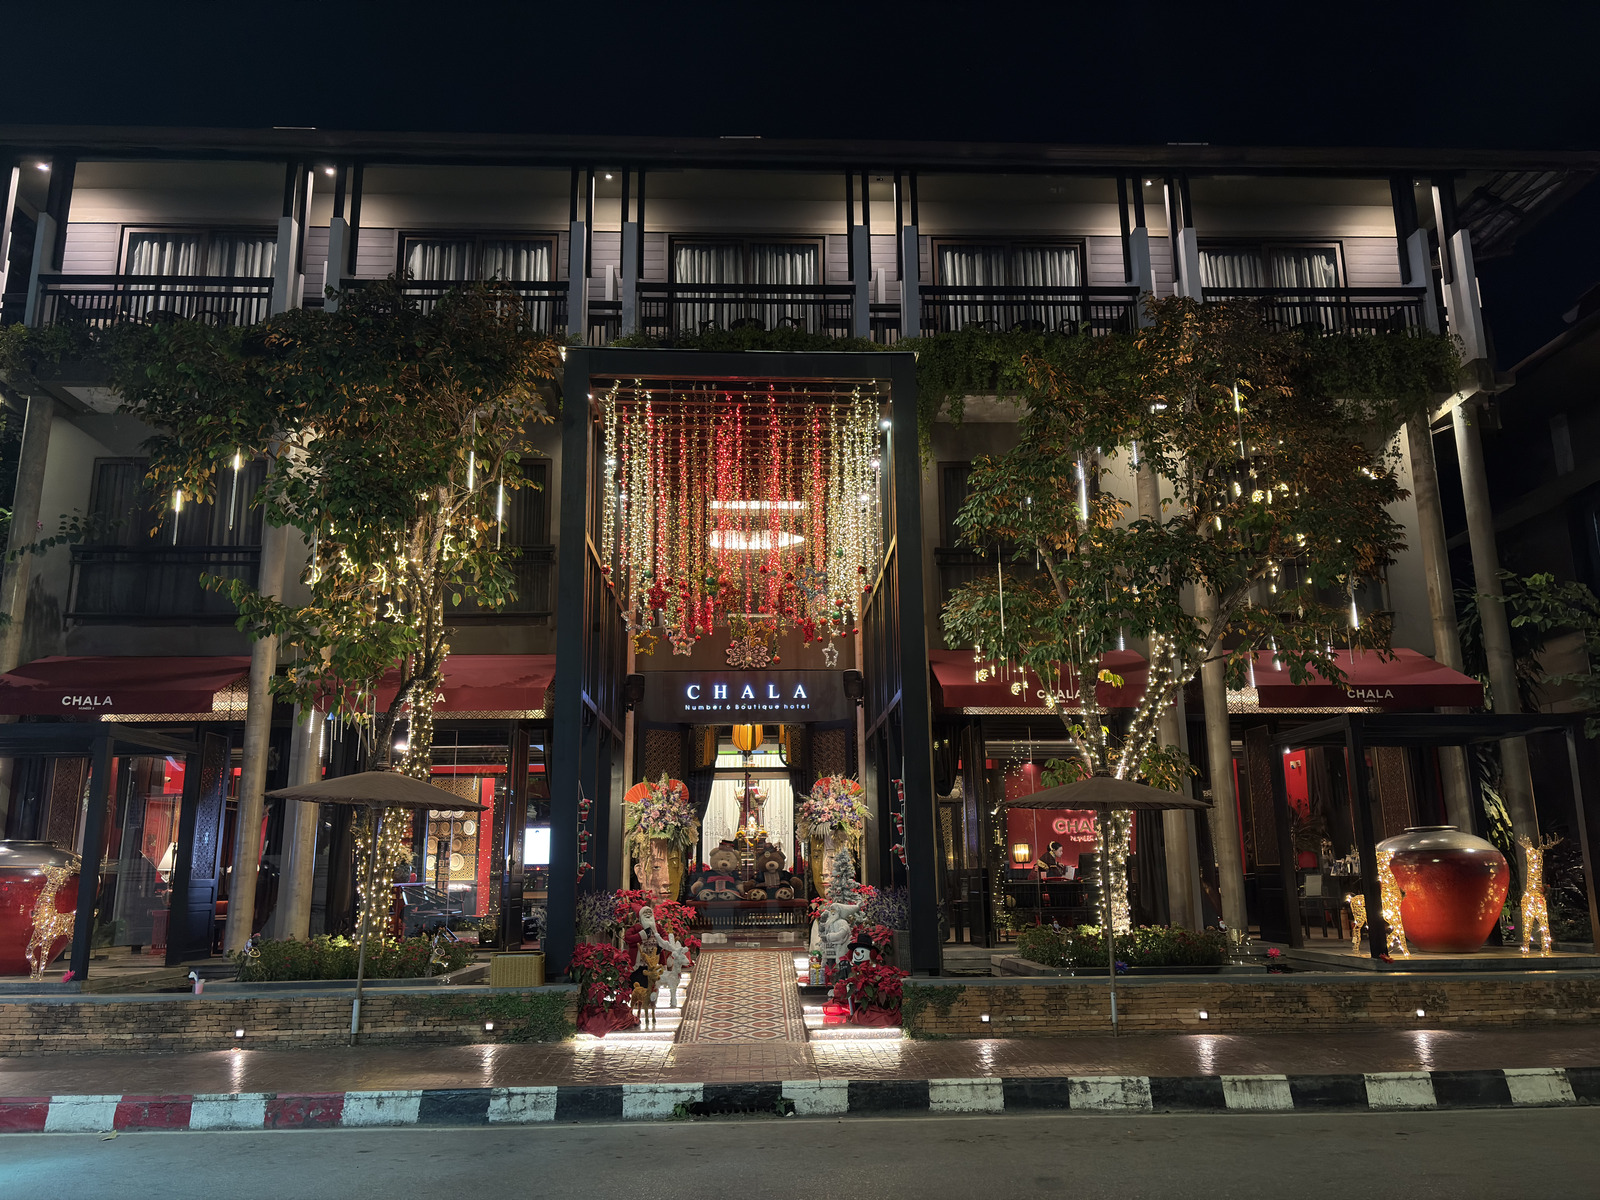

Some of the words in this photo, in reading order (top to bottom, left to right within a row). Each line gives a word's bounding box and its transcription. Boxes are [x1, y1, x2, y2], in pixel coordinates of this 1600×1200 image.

[686, 684, 808, 700] CHALA
[1347, 689, 1394, 699] CHALA
[61, 695, 113, 706] CHALA
[735, 703, 780, 711] Boutique
